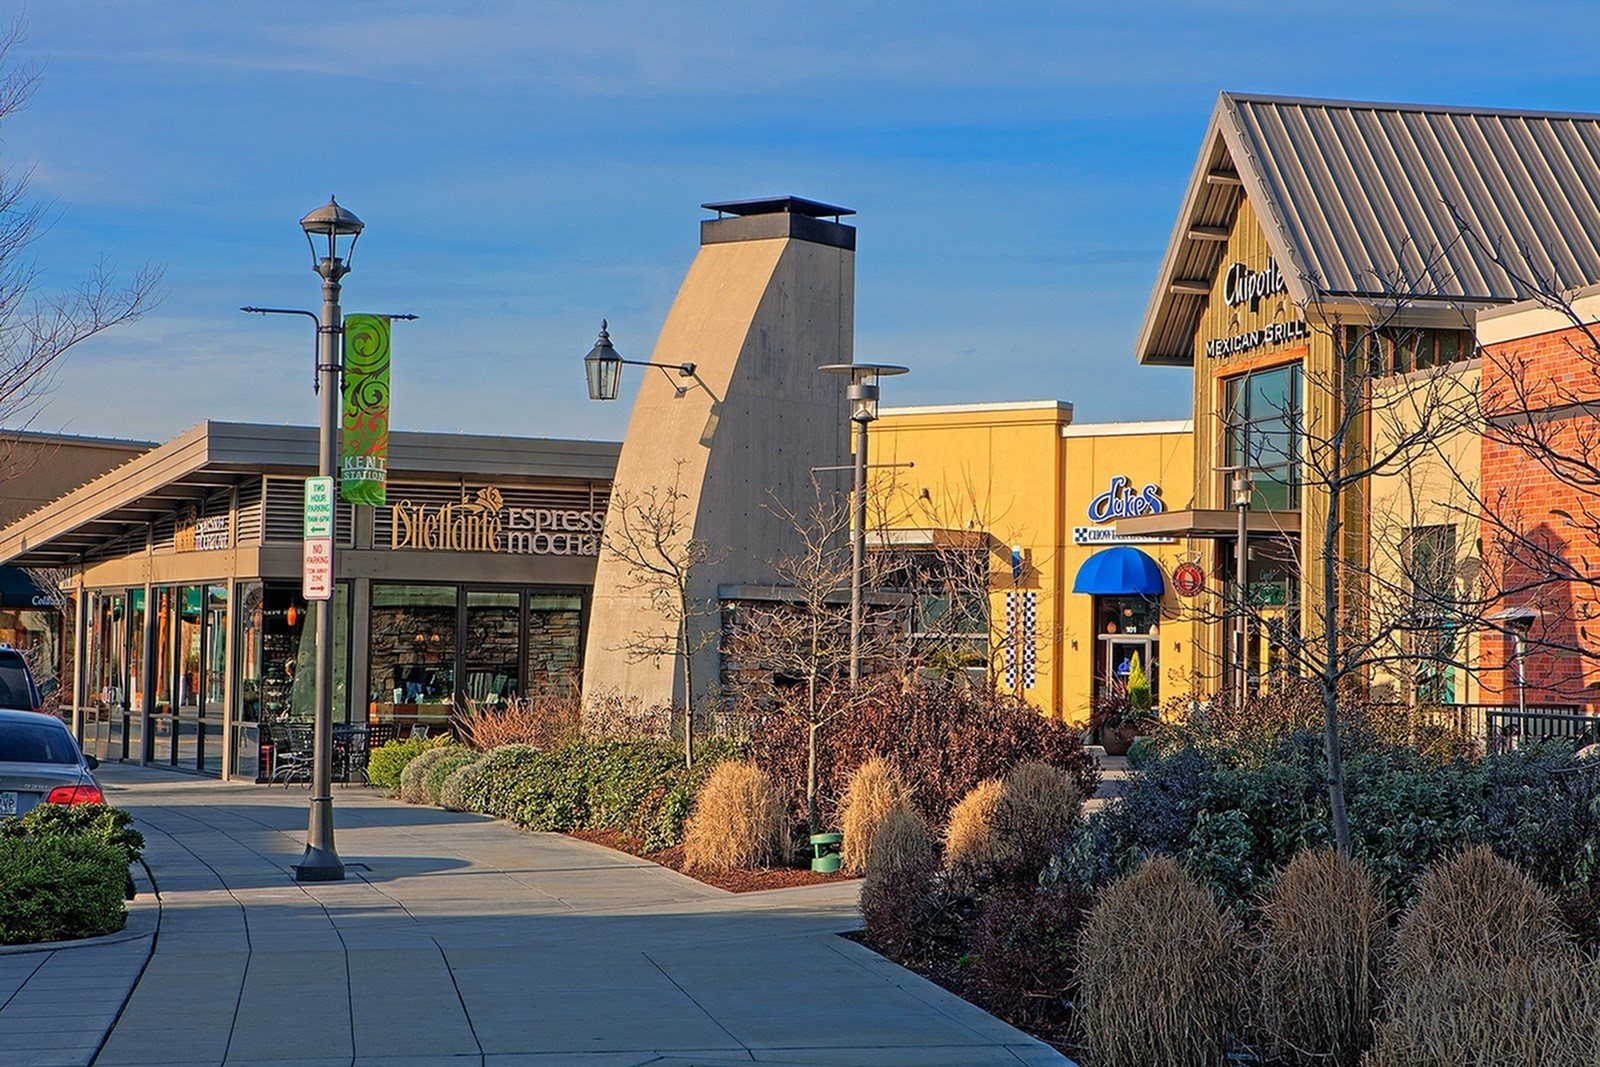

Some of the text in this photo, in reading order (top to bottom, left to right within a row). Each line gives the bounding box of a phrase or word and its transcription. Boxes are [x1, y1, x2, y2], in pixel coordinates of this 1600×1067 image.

[1223, 255, 1283, 312] Chipotle
[1206, 319, 1304, 356] MEXICAN GRILL
[344, 455, 387, 470] KENT
[343, 470, 385, 481] STATION
[314, 484, 325, 492] TWO
[311, 494, 326, 502] HOUR
[307, 504, 329, 512] PARKING
[313, 545, 323, 554] NO
[307, 556, 329, 565] PARKING
